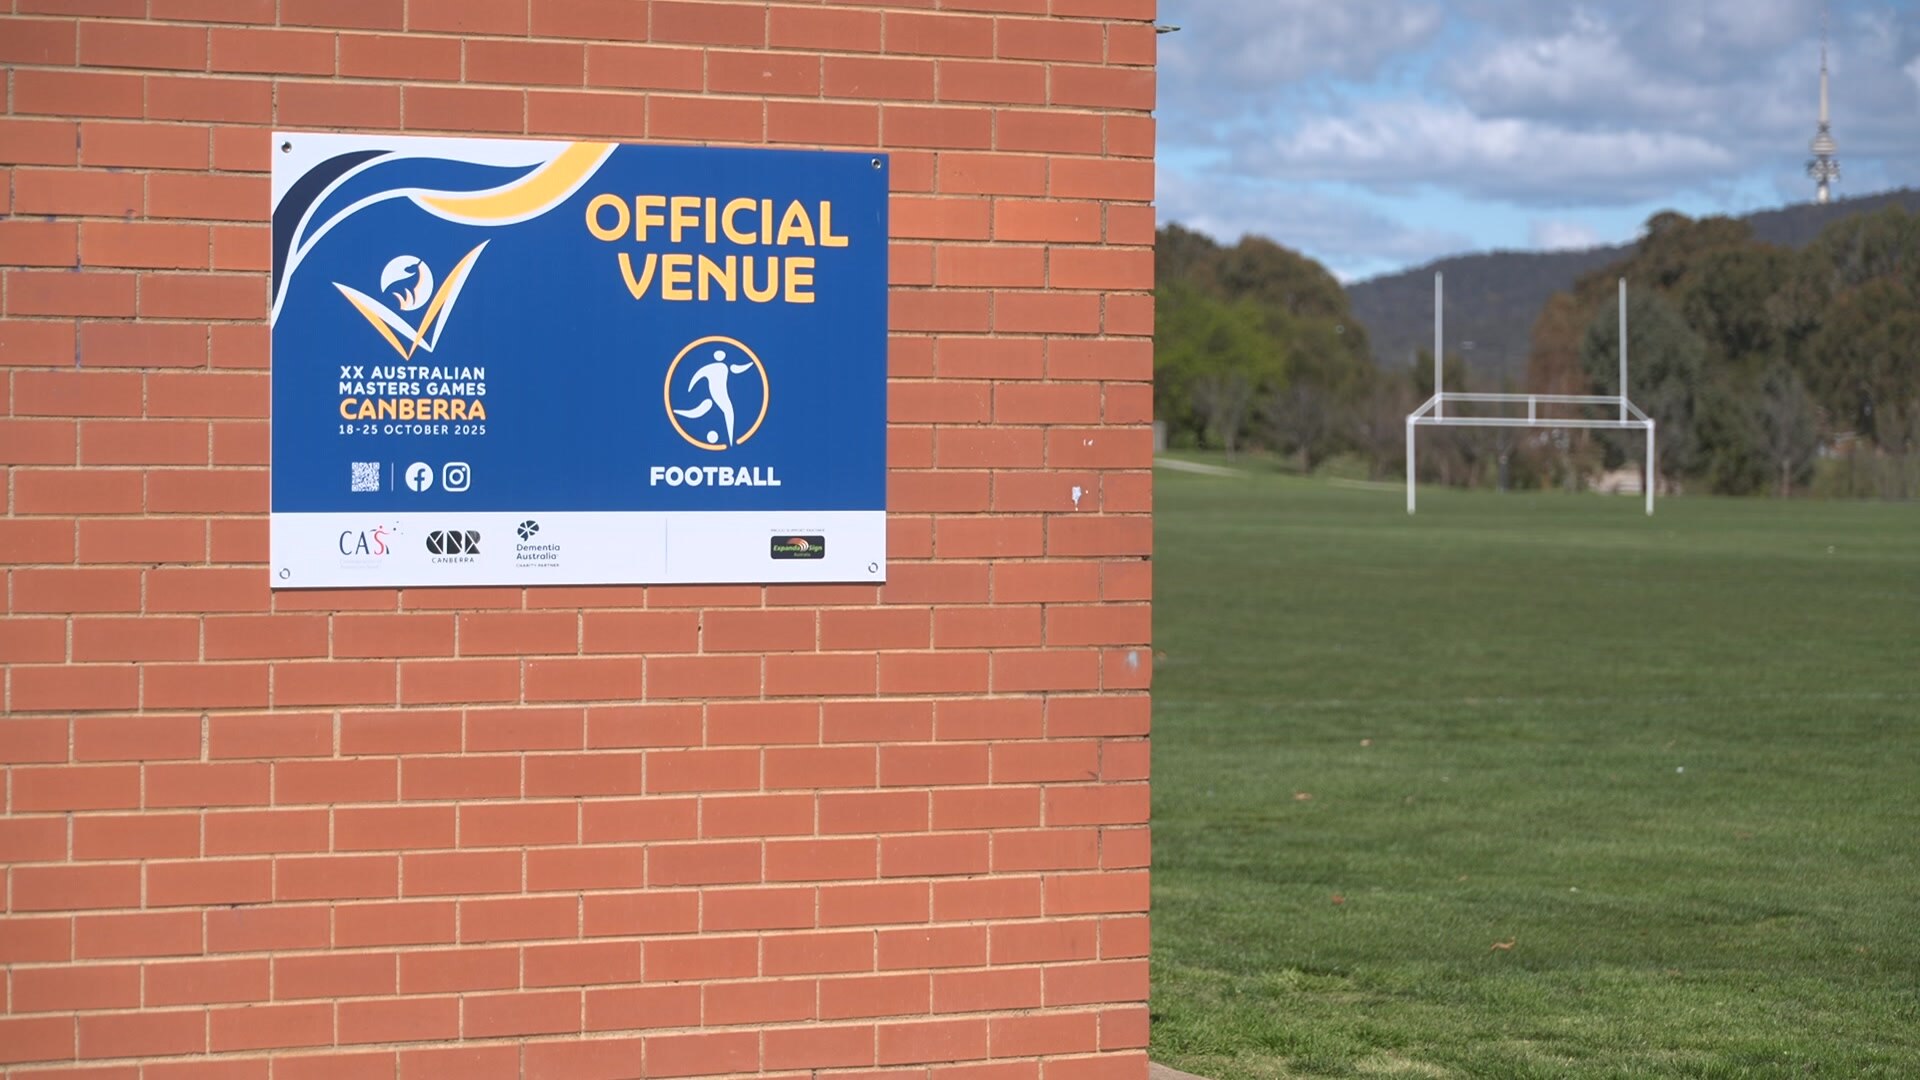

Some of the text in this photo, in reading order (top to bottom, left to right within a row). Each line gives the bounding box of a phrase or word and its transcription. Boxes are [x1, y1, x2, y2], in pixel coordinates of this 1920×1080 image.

[585, 193, 849, 247] OFFICIAL
[617, 252, 816, 303] VENUE
[340, 365, 485, 380] XX AUSTRALIAN
[339, 381, 486, 396] MASTERS GAMES
[340, 398, 486, 420] CANBERRA
[339, 424, 486, 435] 18-25 OCTOBER 2025
[650, 466, 782, 486] FOOTBALL
[516, 543, 561, 552] Dementia
[516, 552, 557, 560] Australia
